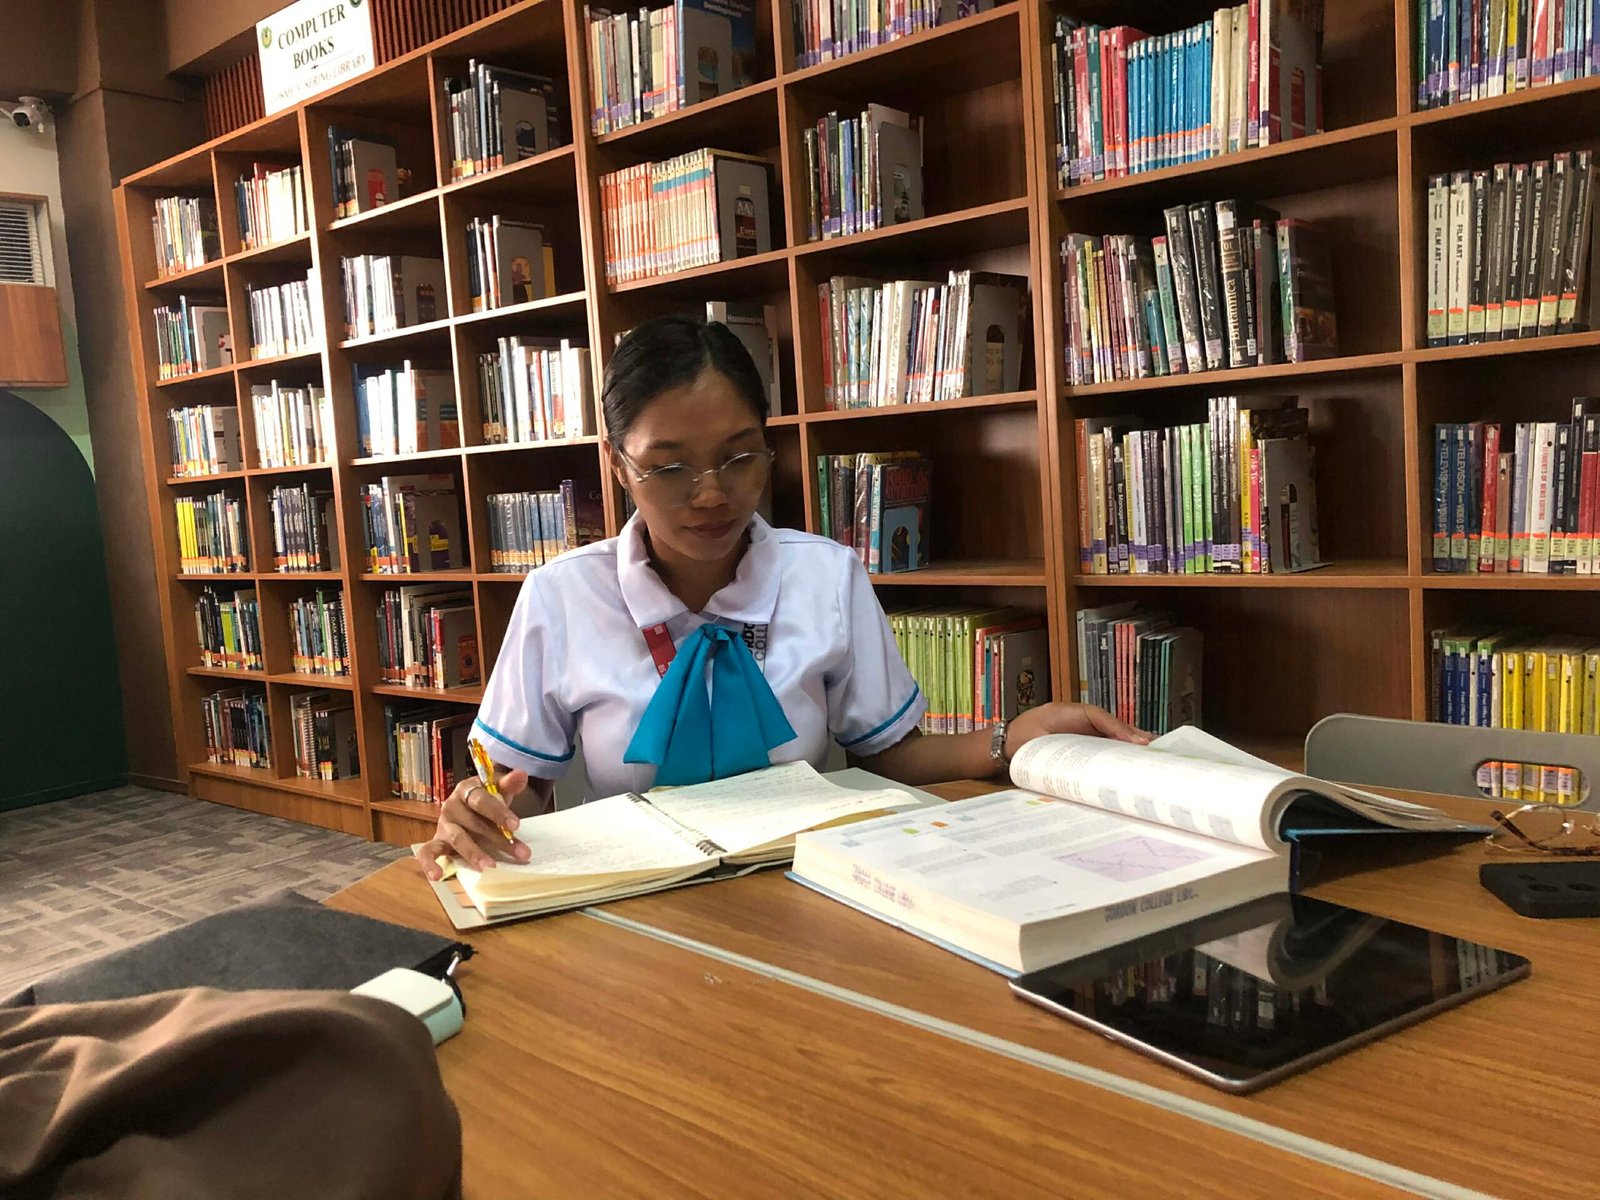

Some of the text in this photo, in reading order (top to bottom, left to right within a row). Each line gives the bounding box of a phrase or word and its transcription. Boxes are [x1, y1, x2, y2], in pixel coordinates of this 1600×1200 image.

[278, 4, 346, 50] COMPUTER
[293, 36, 335, 69] BOOKS
[1531, 225, 1539, 258] Communication
[1510, 262, 1518, 276] Theory
[1528, 260, 1537, 274] Theory
[1228, 278, 1241, 341] Britannica
[1440, 445, 1448, 494] TELEVISION
[1456, 447, 1465, 494] TELEVISION
[1541, 447, 1549, 474] ELEMENTS
[1456, 504, 1465, 523] VIDEO
[1538, 500, 1546, 520] EDITING
[1141, 890, 1173, 912] COLLEGE
